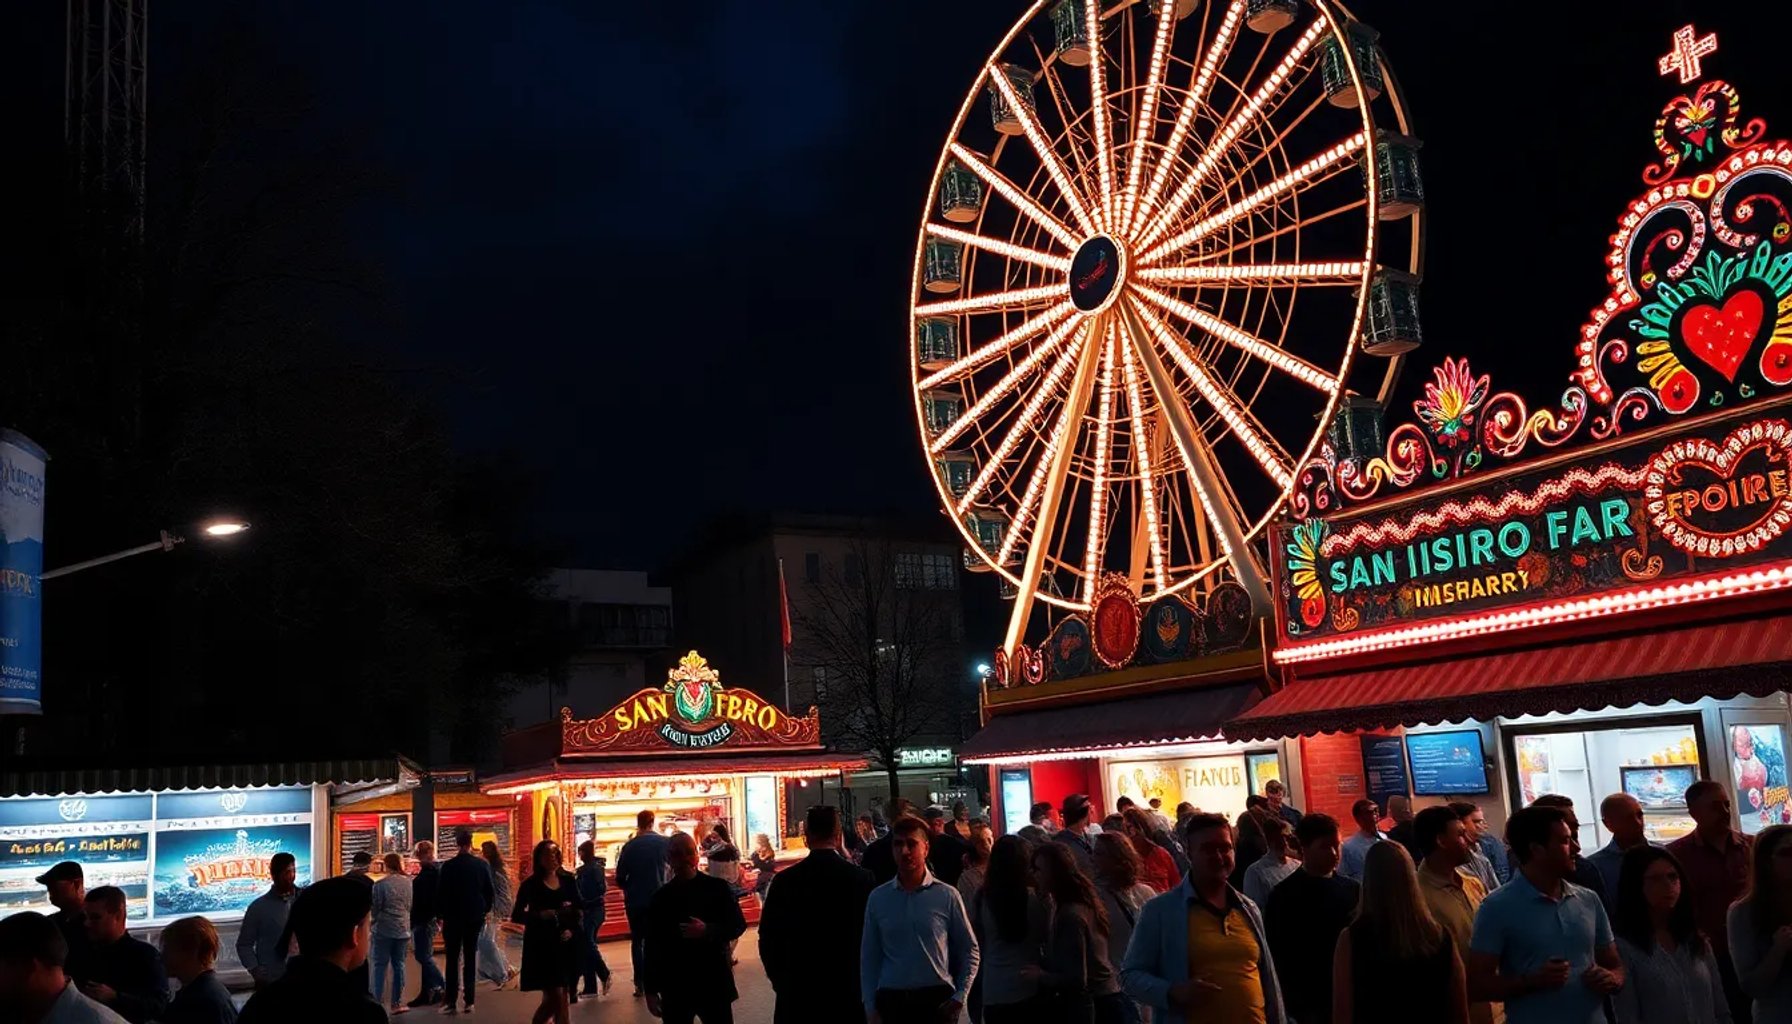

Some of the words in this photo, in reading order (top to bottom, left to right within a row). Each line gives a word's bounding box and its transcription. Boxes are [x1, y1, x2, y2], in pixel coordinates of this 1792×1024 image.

[1329, 550, 1396, 593] SAN
[1407, 521, 1531, 578] IISIRO
[1546, 499, 1634, 550] FAR
[614, 693, 669, 731] SAN
